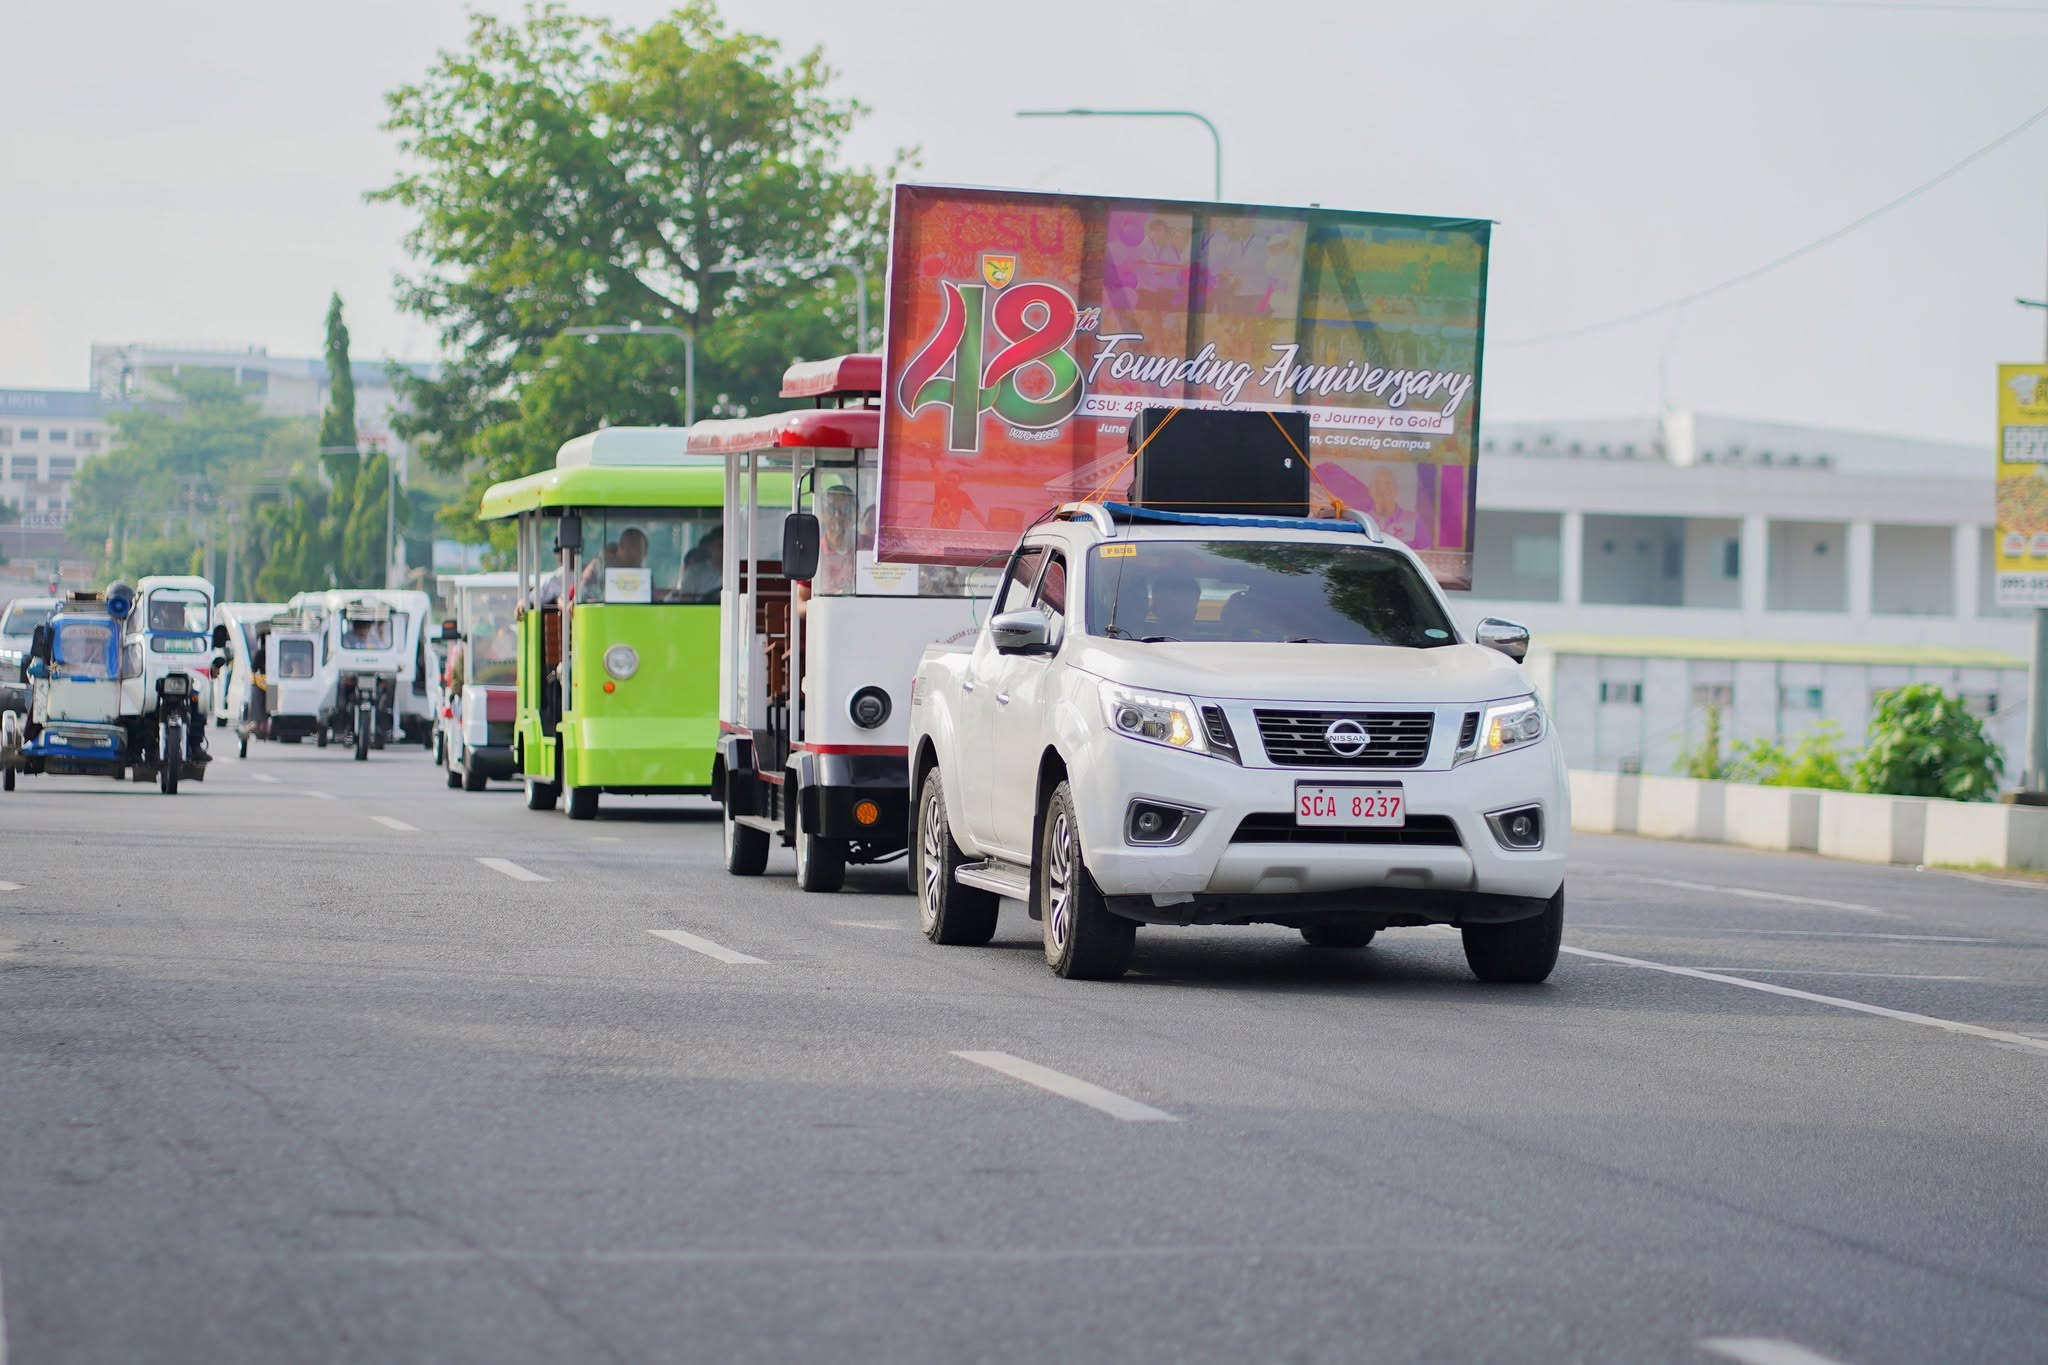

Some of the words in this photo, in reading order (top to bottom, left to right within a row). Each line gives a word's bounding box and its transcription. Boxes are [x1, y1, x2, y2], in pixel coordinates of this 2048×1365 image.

[898, 280, 1086, 452] 48
[1088, 333, 1254, 406] Founding
[1259, 342, 1473, 417] Anniversary
[1086, 399, 1121, 412] CSU:
[1124, 401, 1142, 413] 48
[1097, 423, 1127, 434] June
[1324, 411, 1385, 429] Journey
[1389, 415, 1403, 427] to
[1407, 416, 1442, 429] Gold
[1325, 435, 1349, 445] CSU
[1350, 436, 1381, 449] Carig
[1382, 437, 1431, 451] Campus
[1301, 796, 1337, 817] SCA
[1352, 797, 1401, 818] 8237
